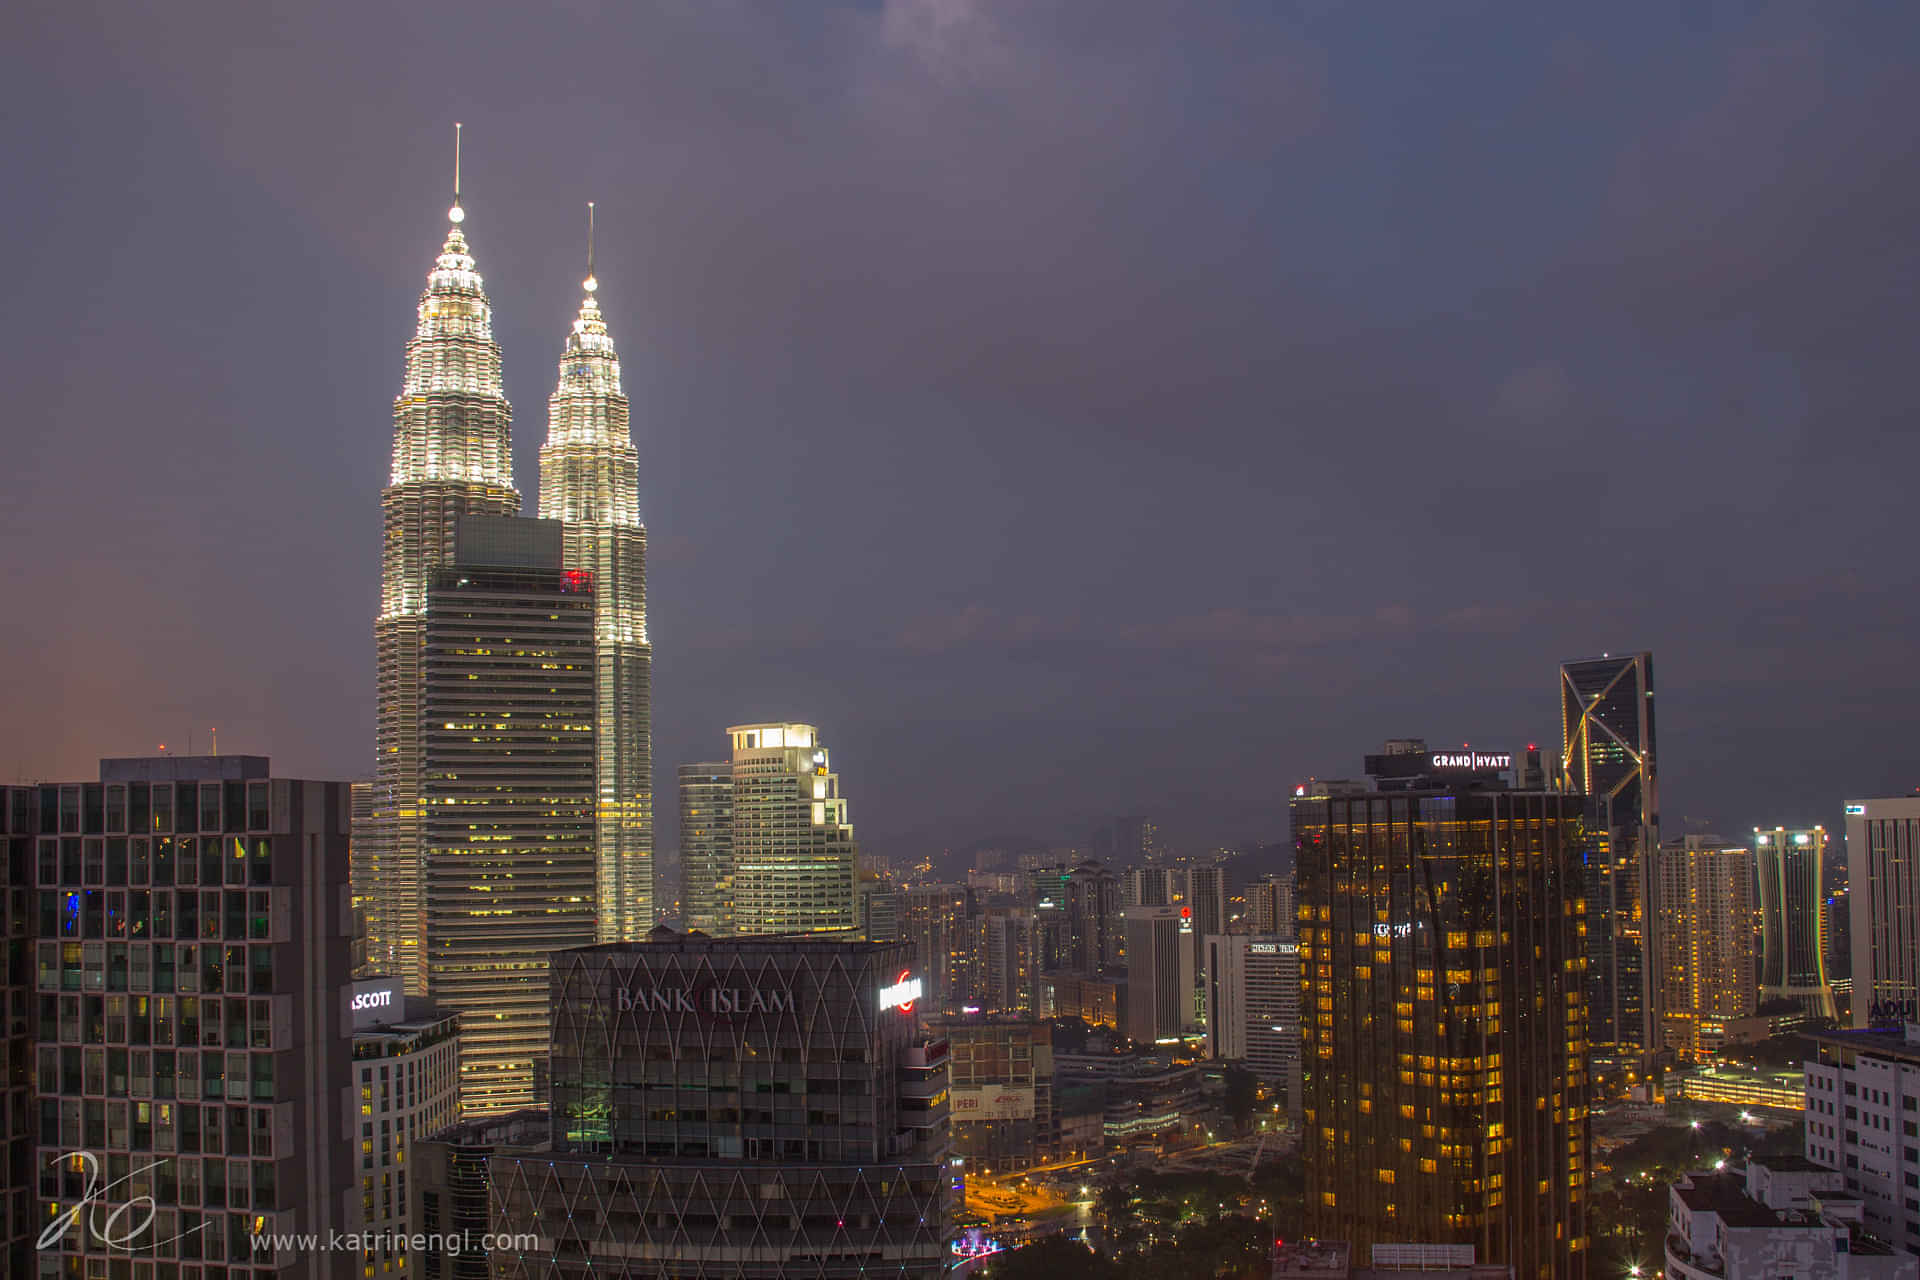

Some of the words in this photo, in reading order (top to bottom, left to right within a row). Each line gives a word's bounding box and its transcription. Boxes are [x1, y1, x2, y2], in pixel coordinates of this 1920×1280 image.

[1433, 755, 1471, 767] GRAND
[1476, 755, 1511, 767] HYATT
[616, 987, 696, 1013] BANK
[710, 987, 797, 1013] ISLAM
